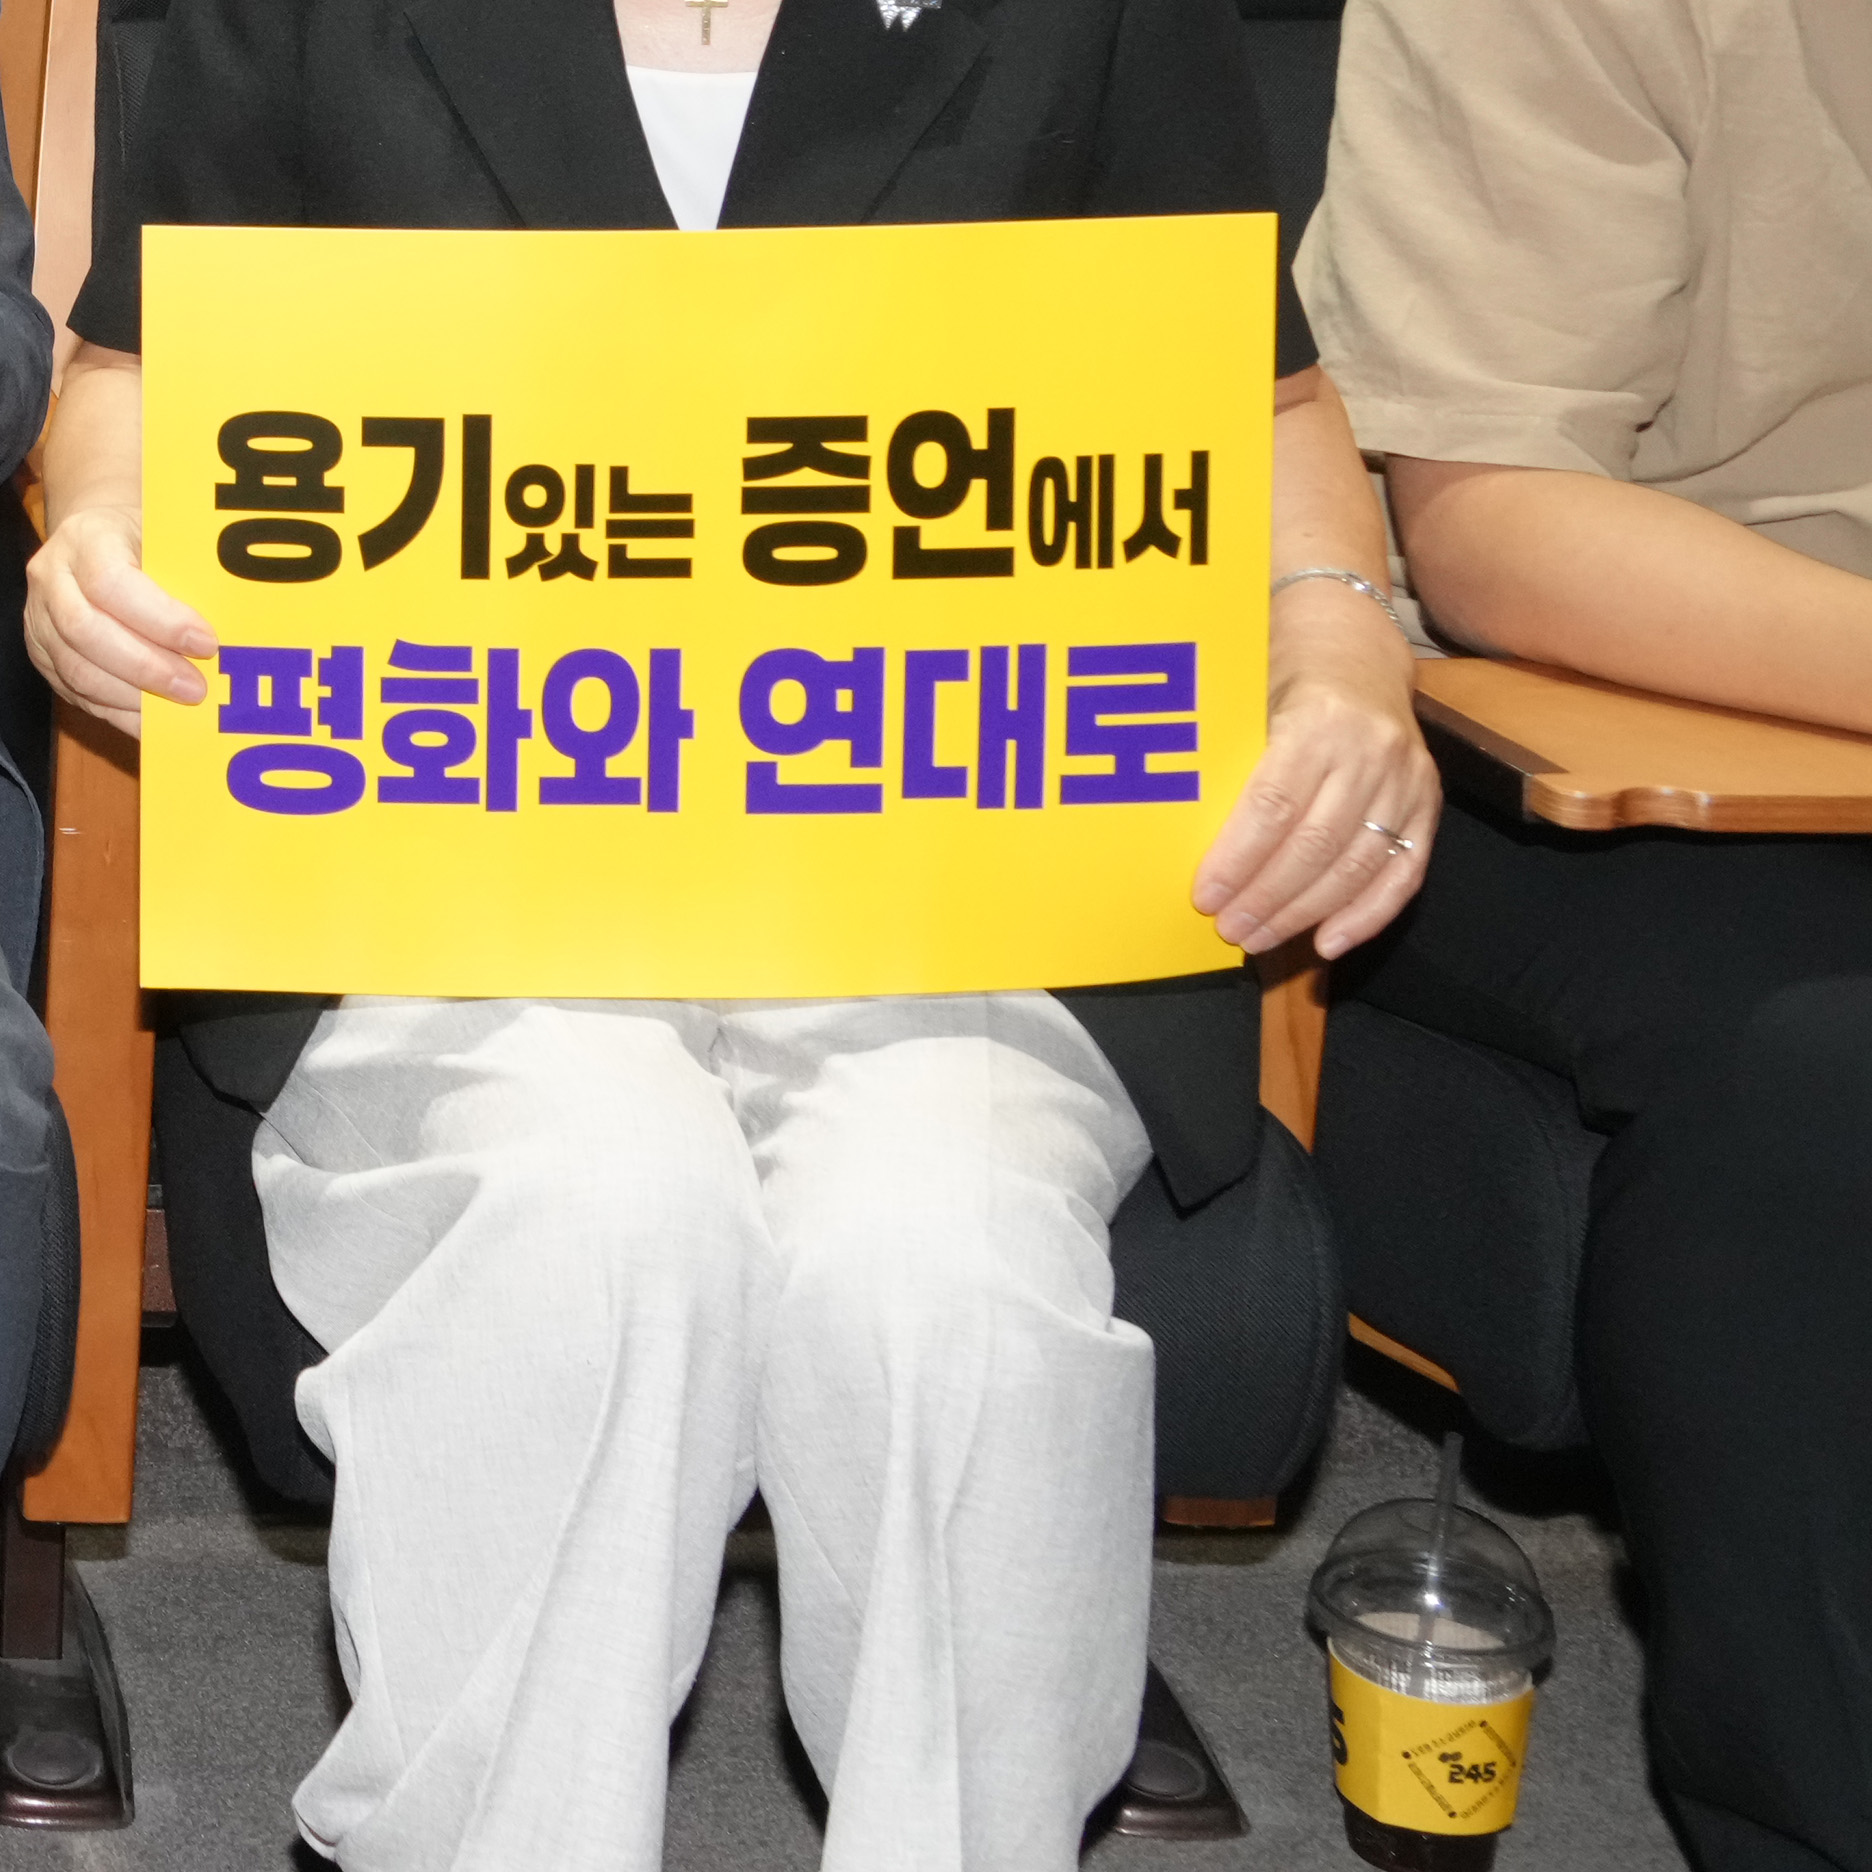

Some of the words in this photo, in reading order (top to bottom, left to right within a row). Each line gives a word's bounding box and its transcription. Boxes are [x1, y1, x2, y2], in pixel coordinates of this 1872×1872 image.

[213, 411, 694, 584] 용기있는
[740, 407, 1210, 586] 증언에서
[217, 640, 695, 815] 평화와
[739, 641, 1201, 814] 연대로
[1447, 1761, 1497, 1784] 245
